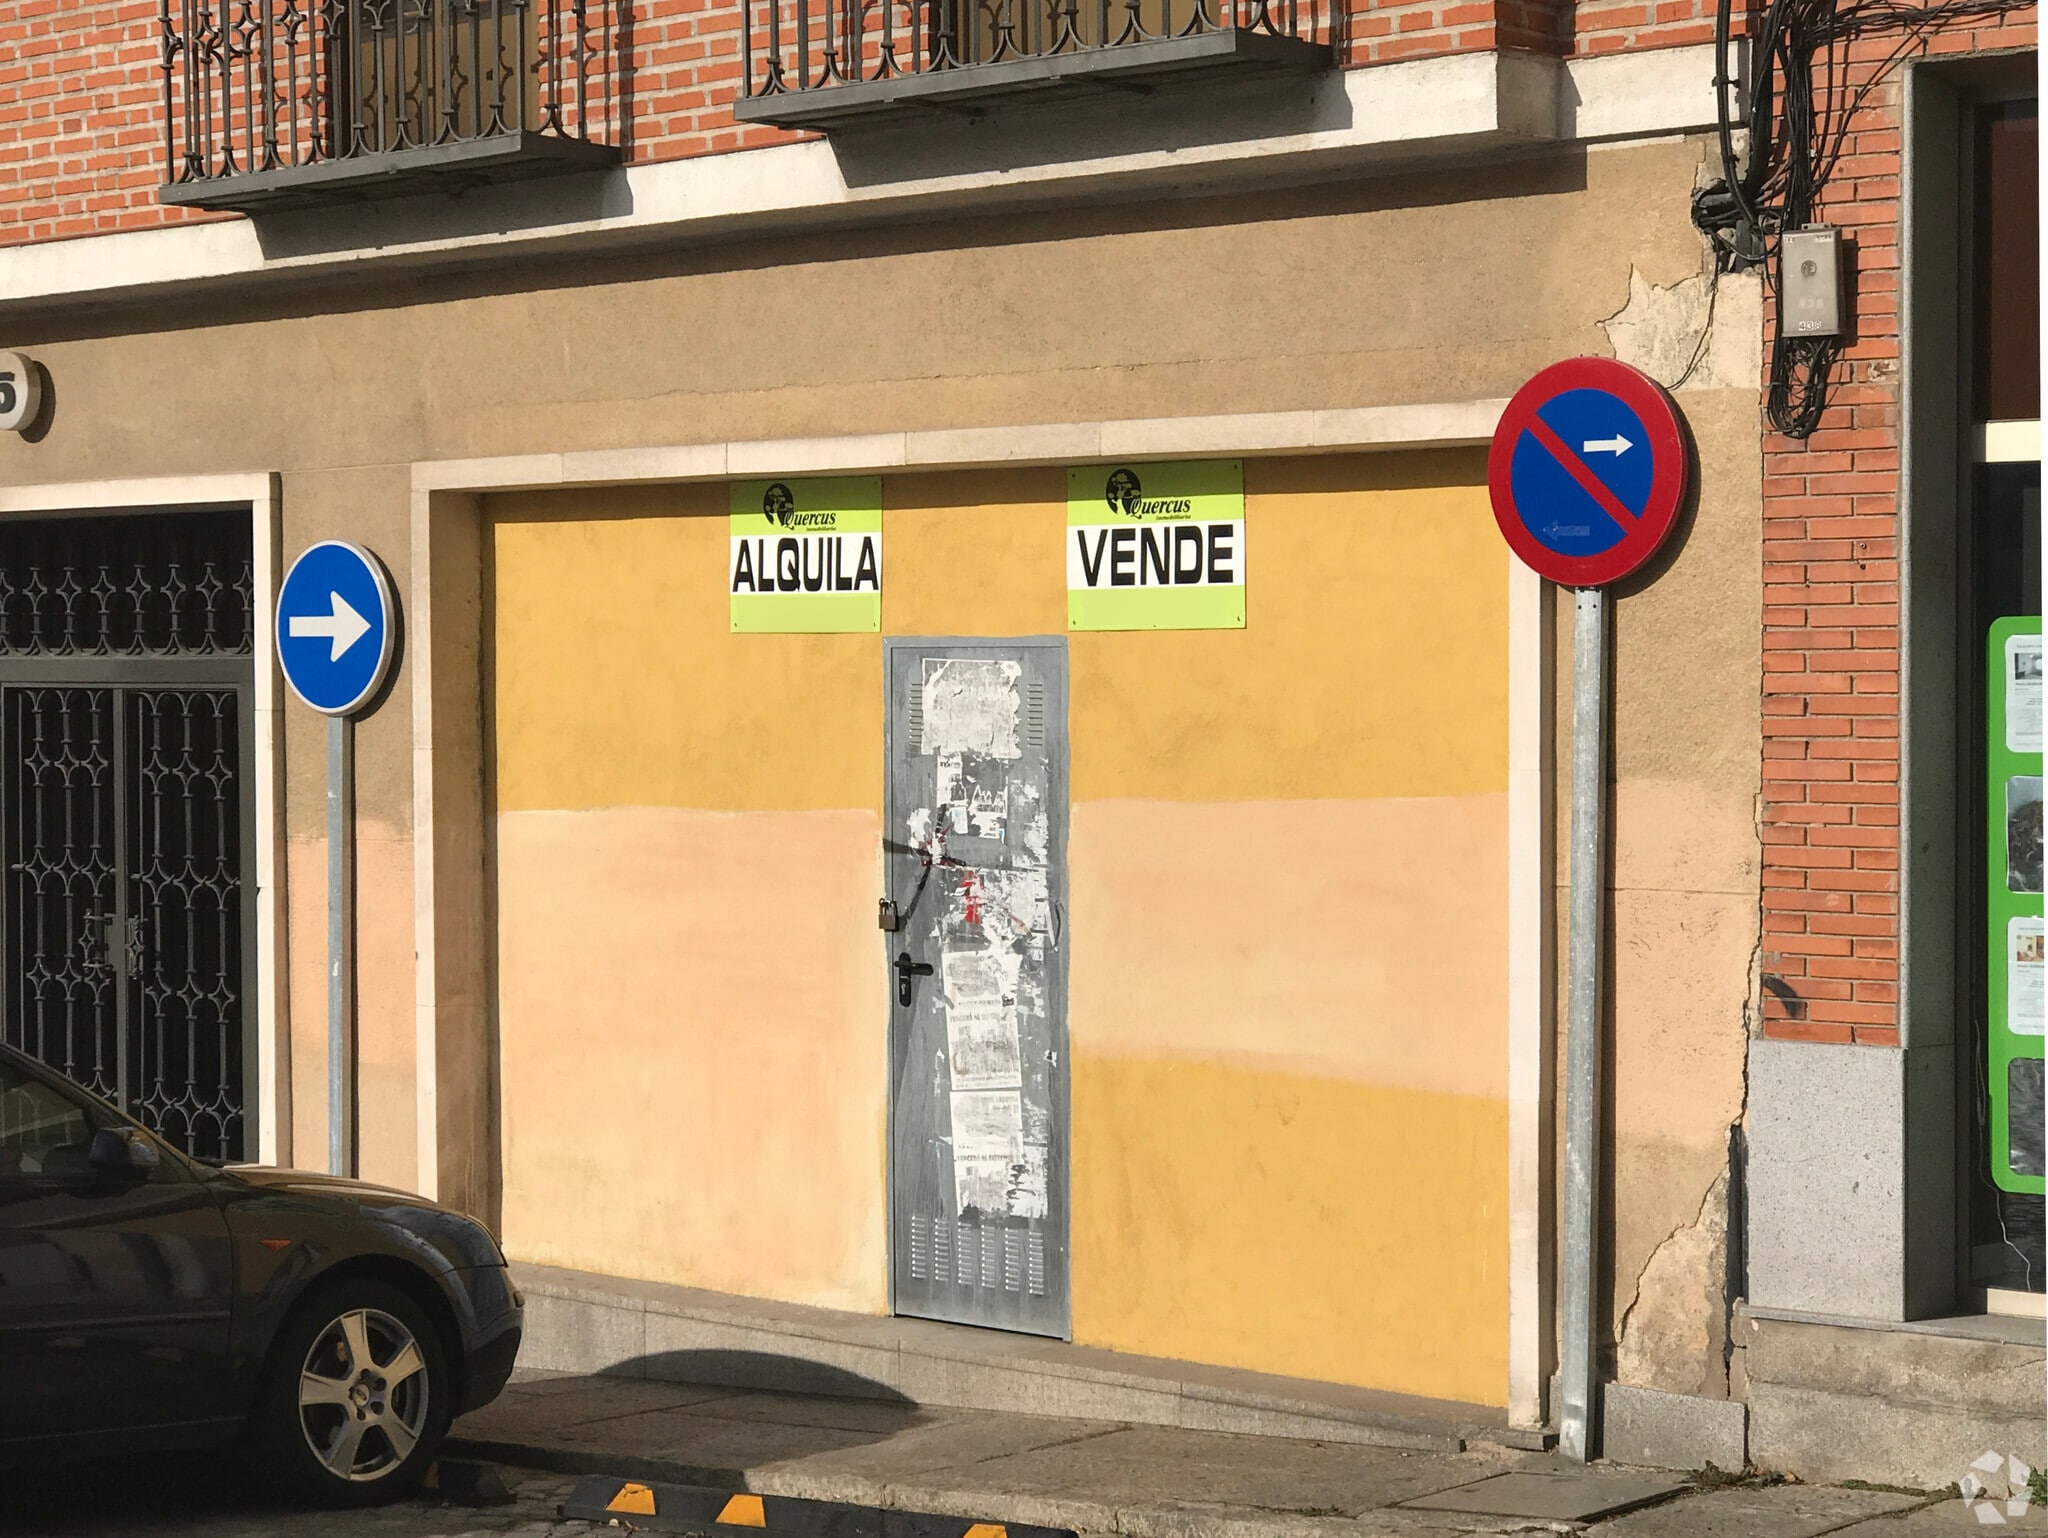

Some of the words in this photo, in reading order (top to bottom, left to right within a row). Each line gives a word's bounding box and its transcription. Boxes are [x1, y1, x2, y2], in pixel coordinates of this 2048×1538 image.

[783, 508, 837, 531] Quercus
[1130, 498, 1192, 520] Quercus
[732, 536, 880, 593] ALQUILA
[1077, 524, 1234, 587] VENDE
